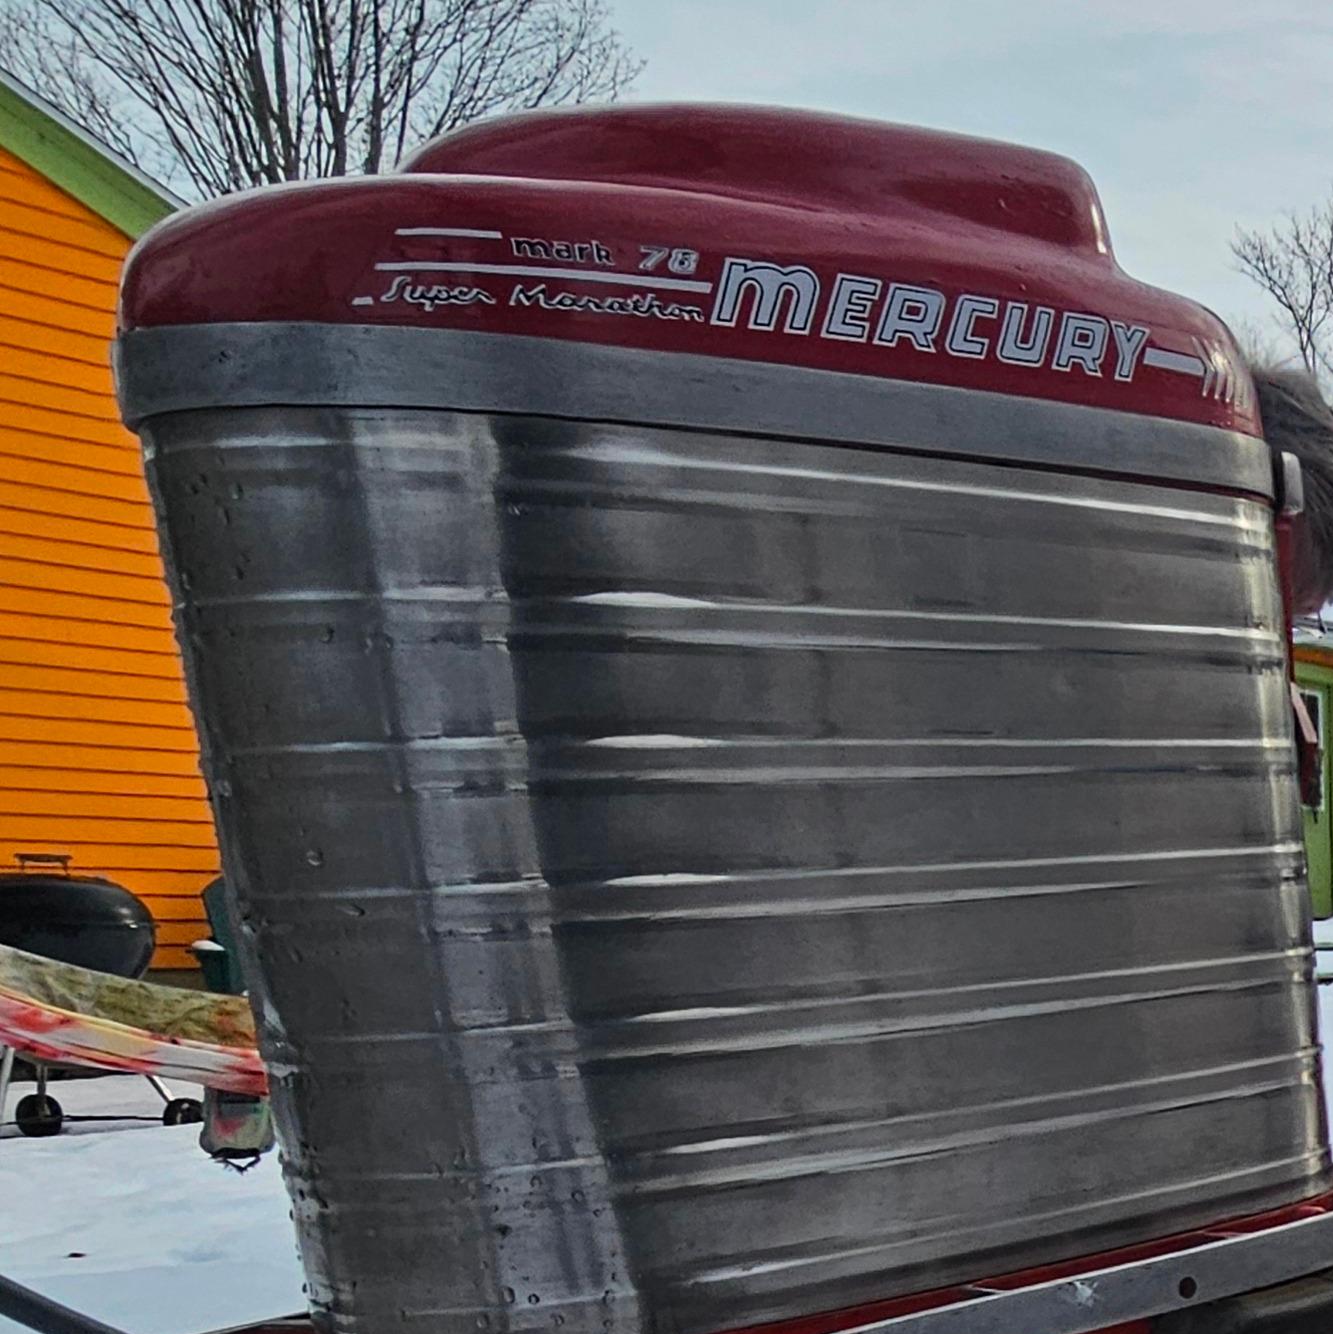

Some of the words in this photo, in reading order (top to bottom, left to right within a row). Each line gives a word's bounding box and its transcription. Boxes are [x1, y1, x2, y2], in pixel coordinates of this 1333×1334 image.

[511, 236, 615, 267] mark
[380, 275, 497, 312] Super
[508, 283, 705, 323] Marathon
